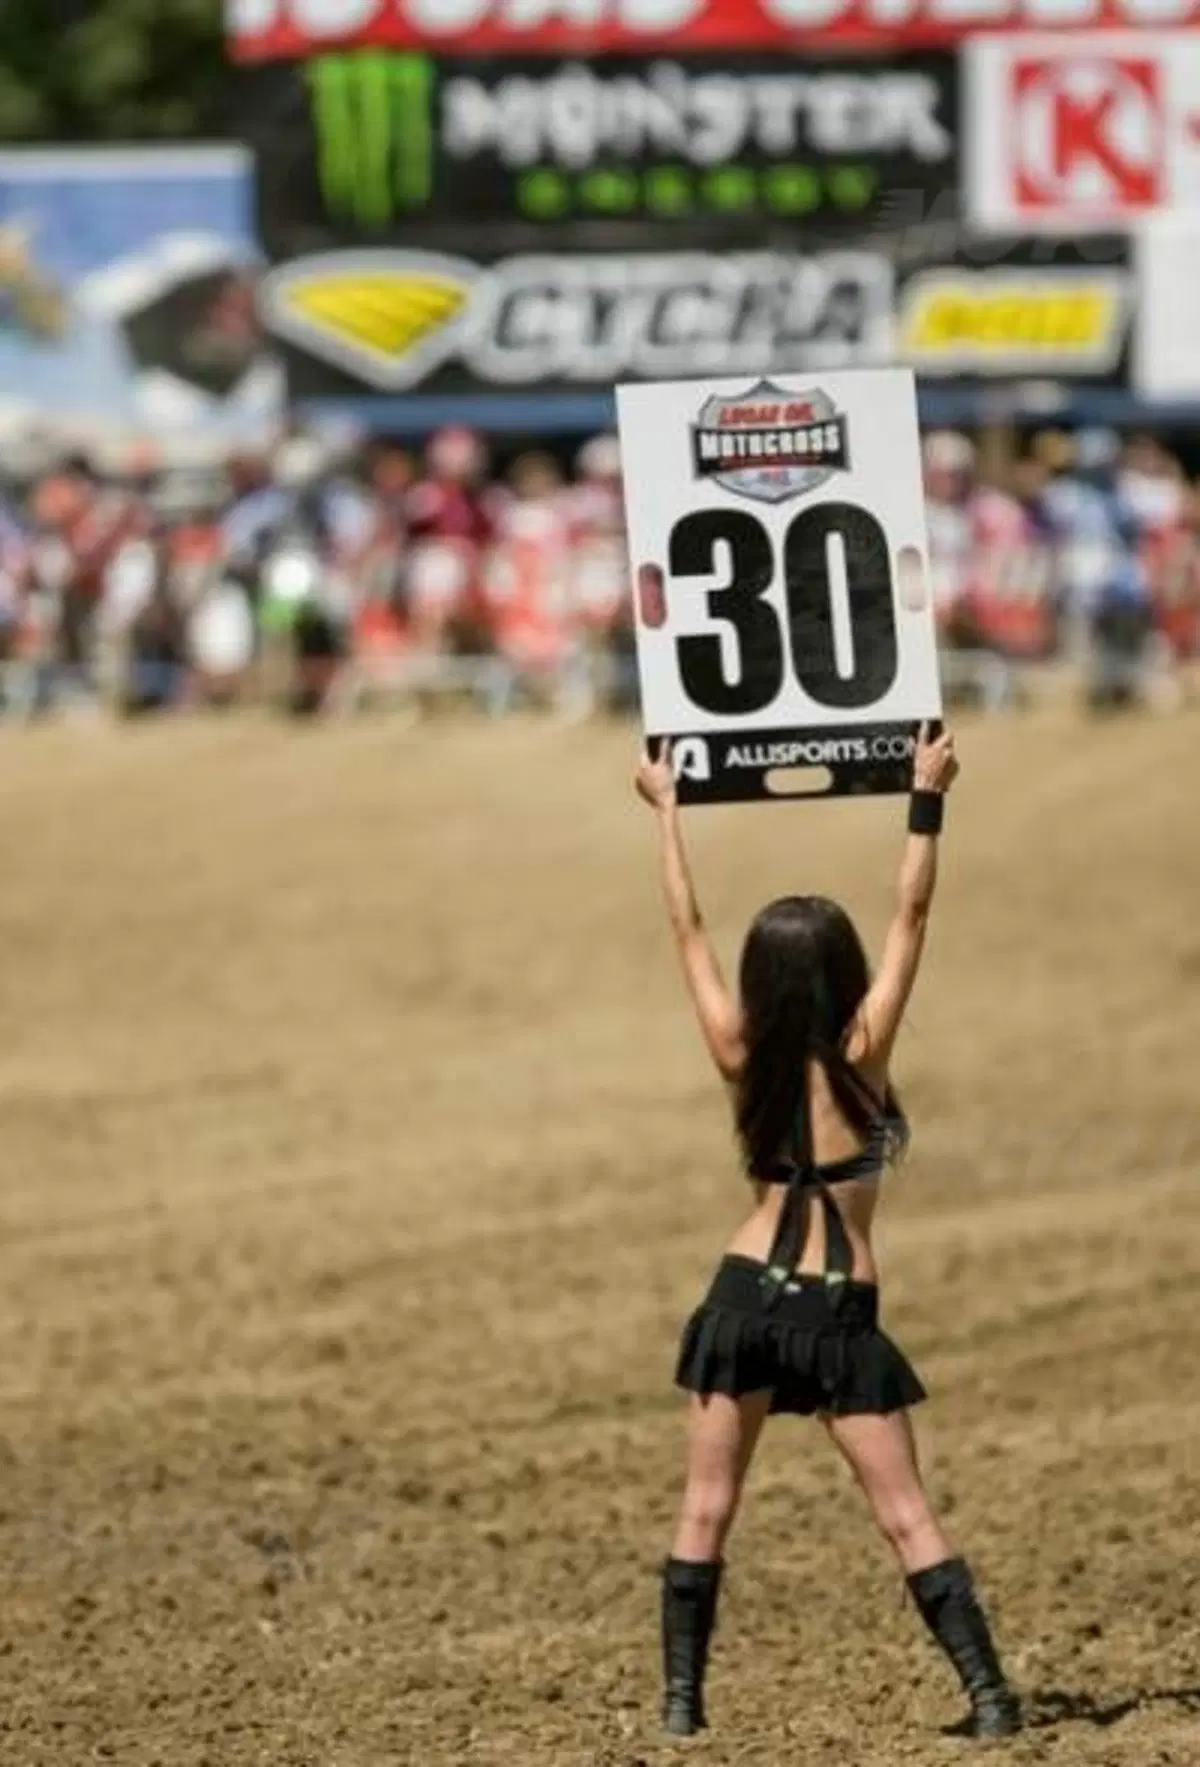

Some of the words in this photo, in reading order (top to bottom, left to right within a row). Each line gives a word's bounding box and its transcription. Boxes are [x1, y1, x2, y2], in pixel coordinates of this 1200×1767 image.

[444, 64, 948, 168] MONSTER
[700, 424, 839, 460] MOTOCROSS
[668, 501, 899, 717] 30
